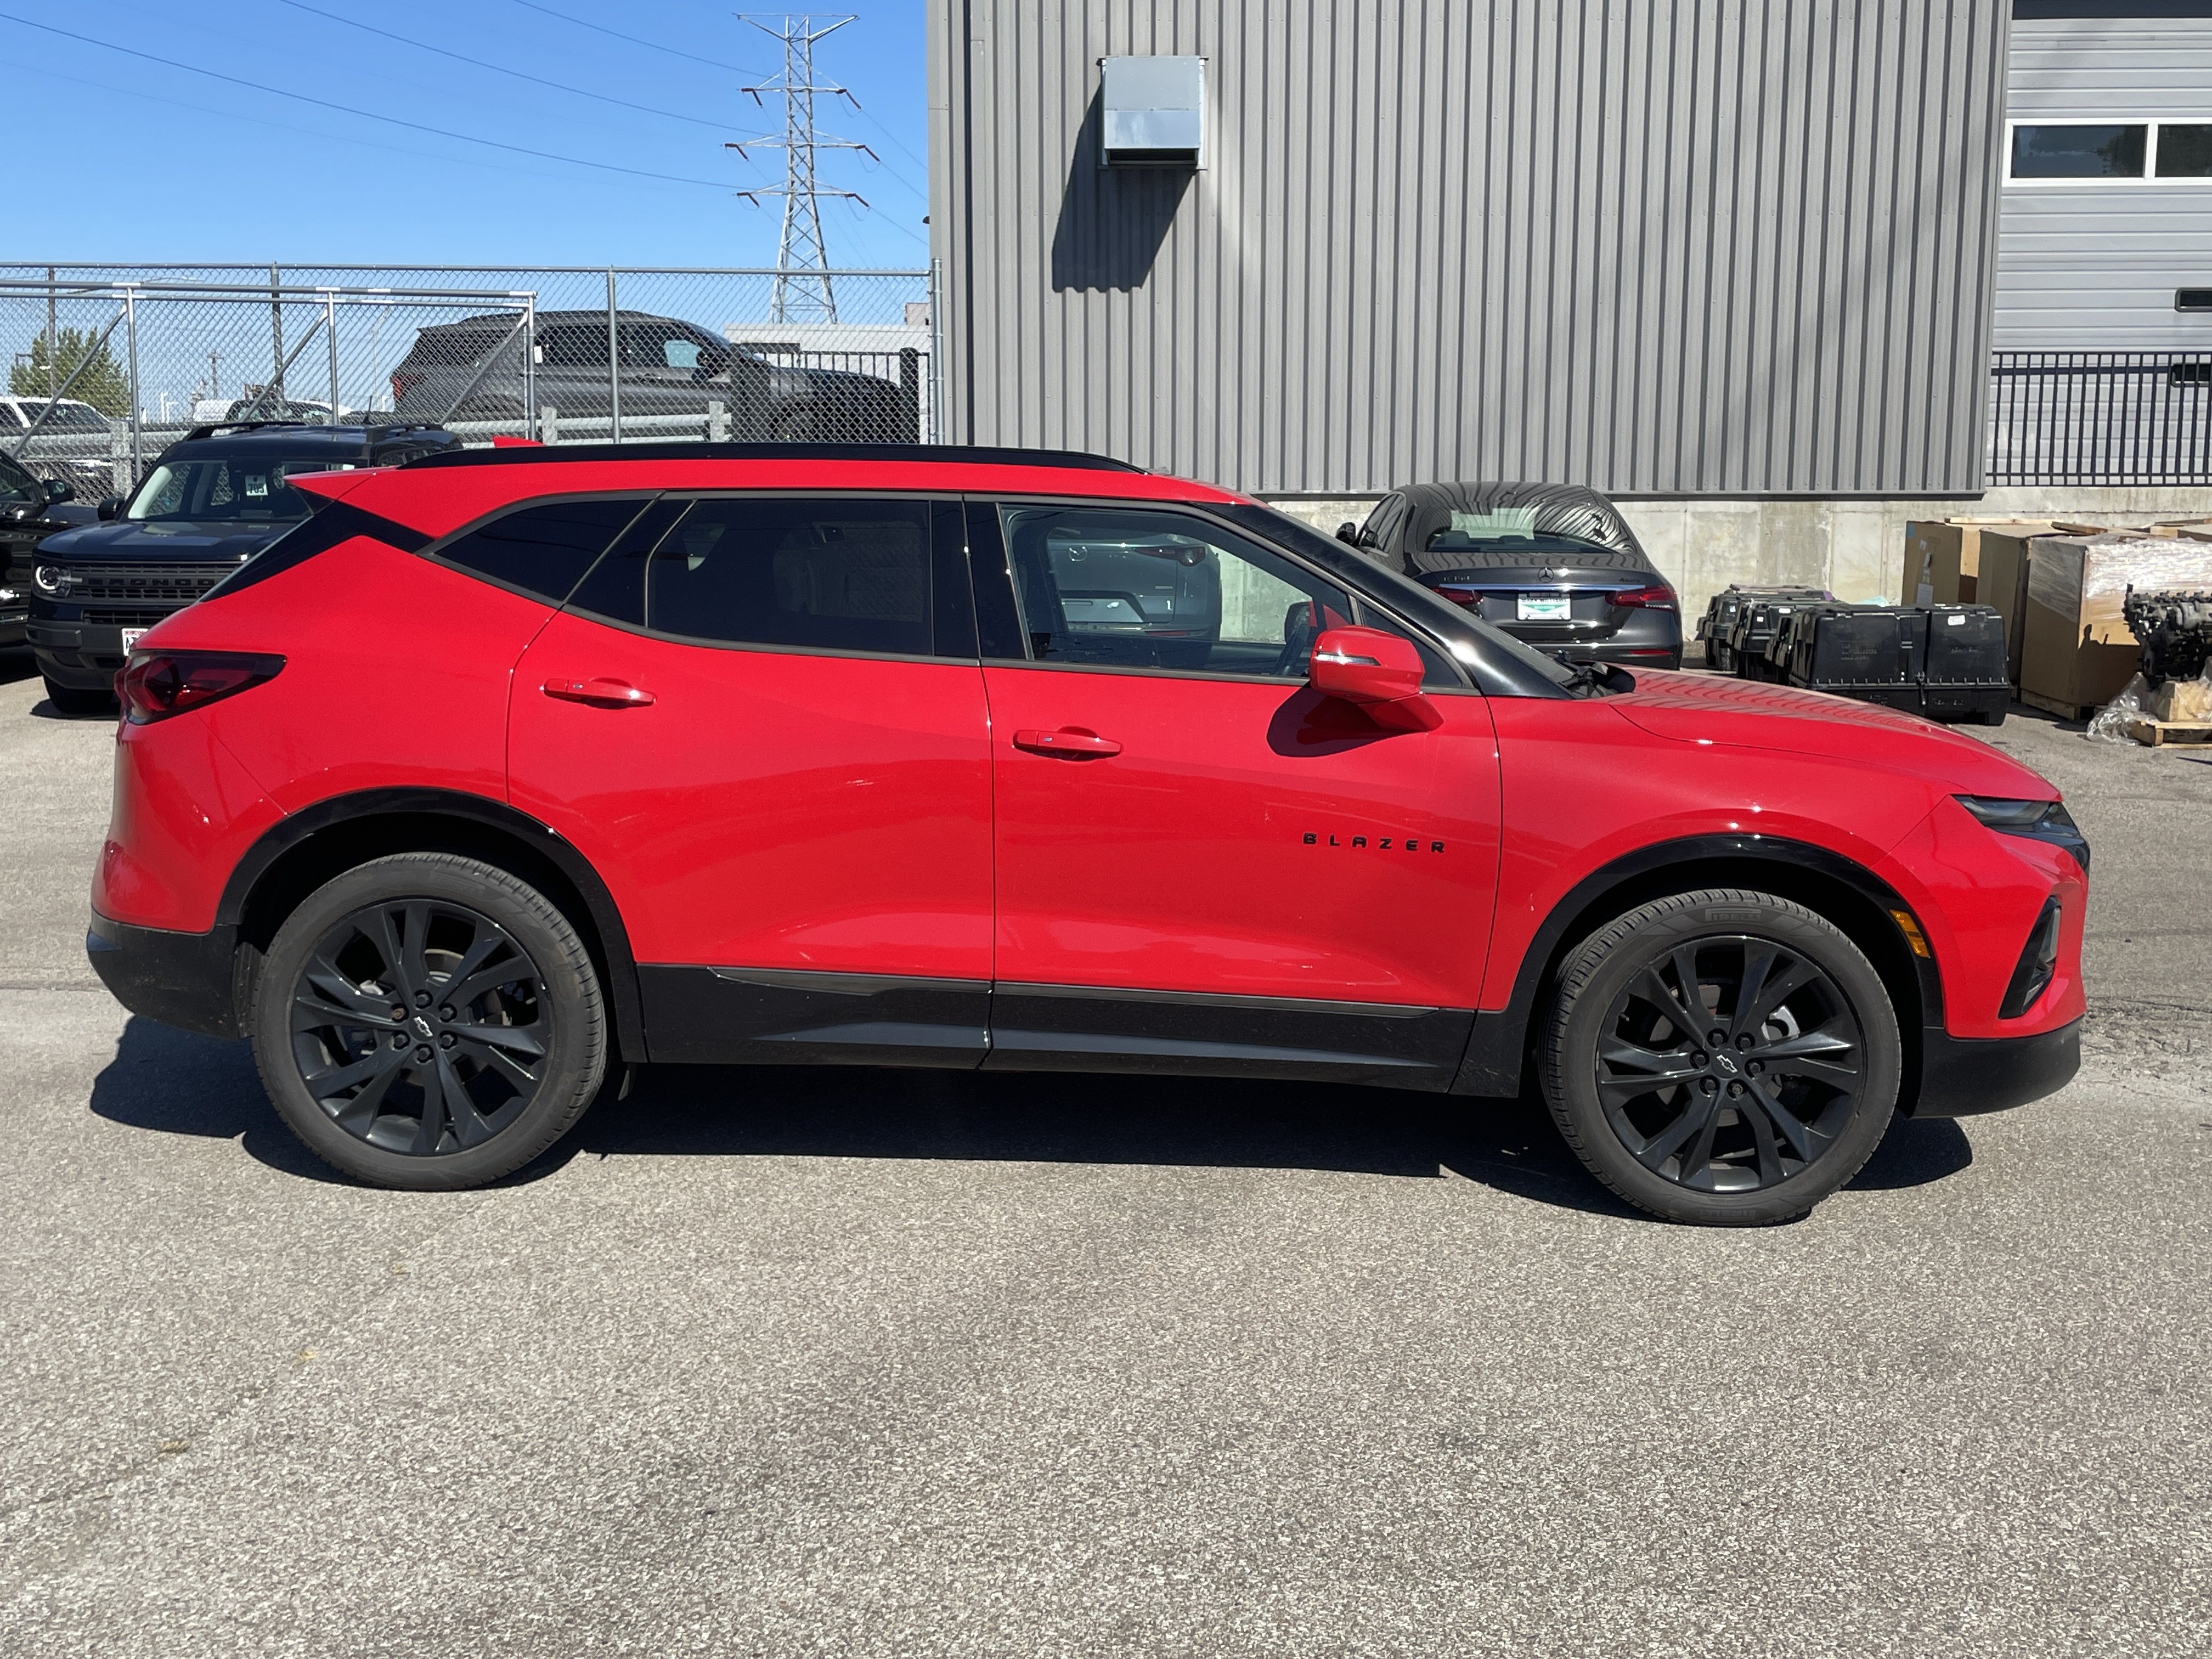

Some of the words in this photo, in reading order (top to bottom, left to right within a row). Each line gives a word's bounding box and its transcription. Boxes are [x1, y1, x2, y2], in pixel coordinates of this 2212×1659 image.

[248, 483, 264, 493] 705
[1303, 832, 1445, 854] BLAZER
[1705, 908, 1762, 922] PIRELLI
